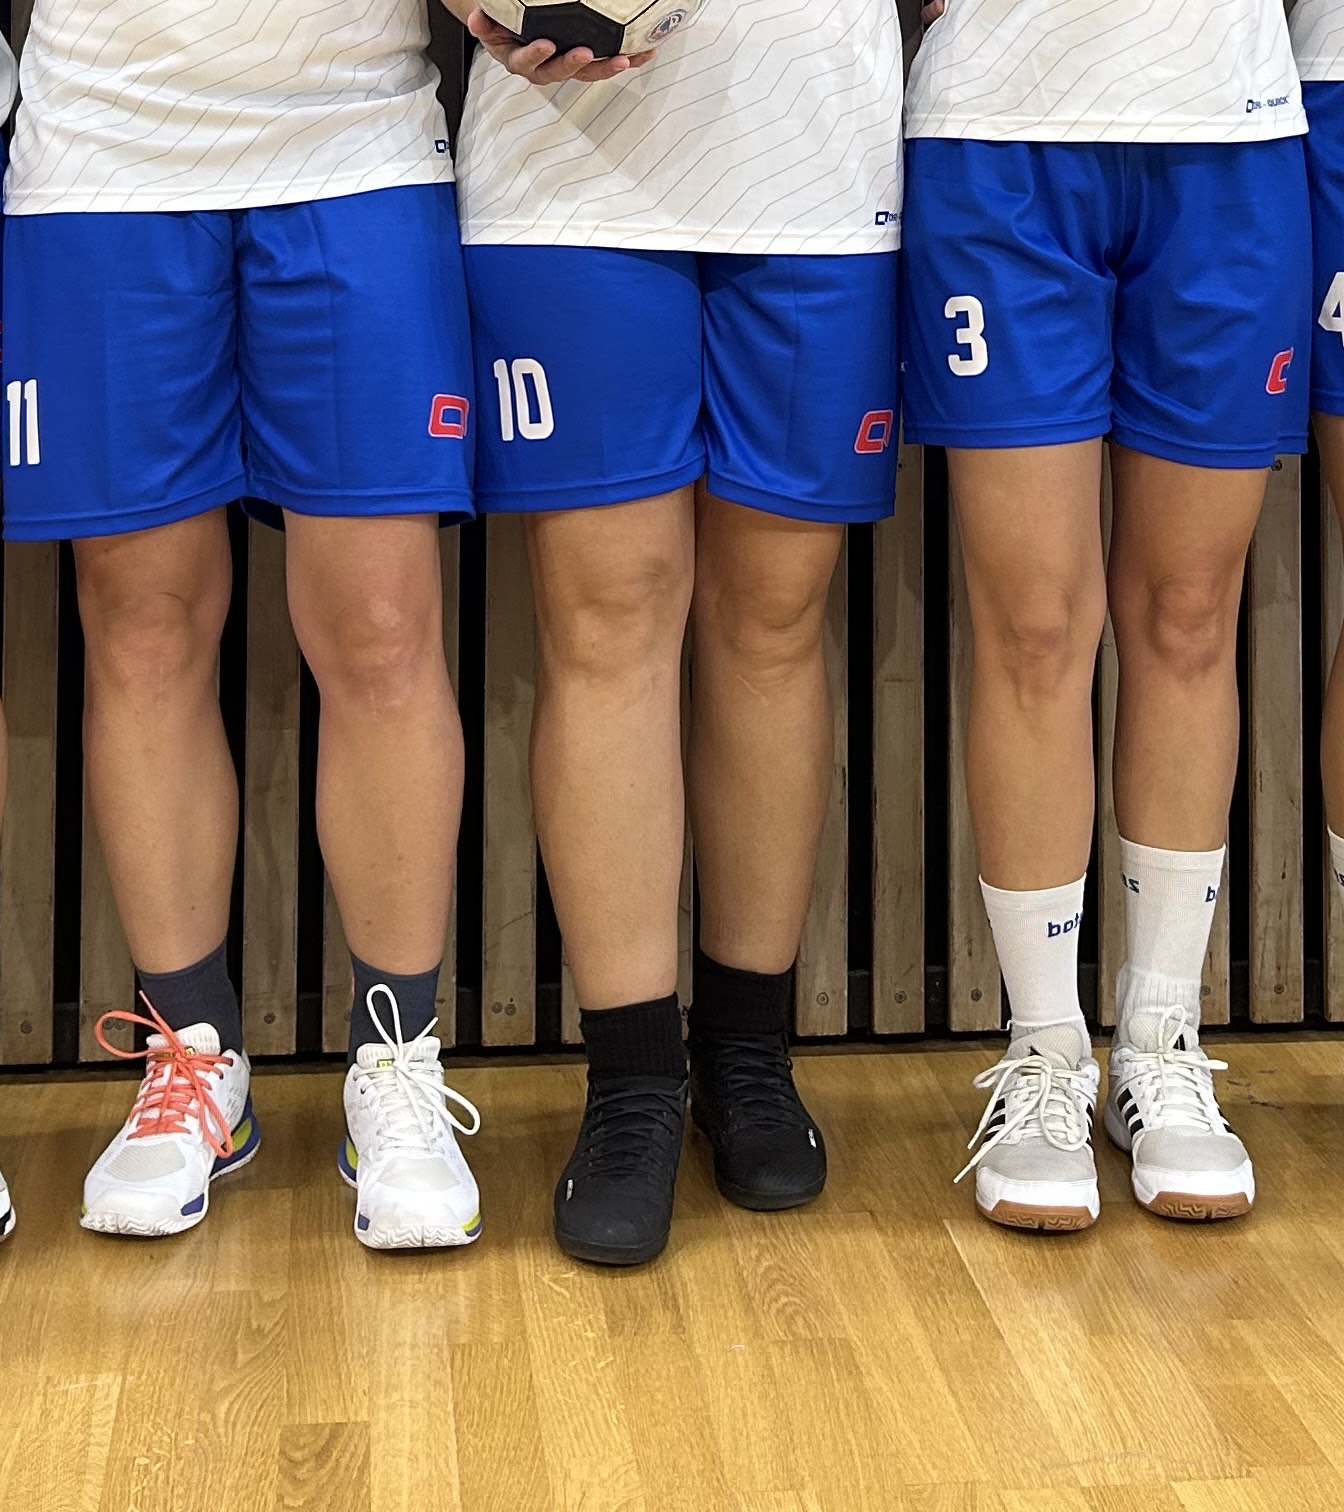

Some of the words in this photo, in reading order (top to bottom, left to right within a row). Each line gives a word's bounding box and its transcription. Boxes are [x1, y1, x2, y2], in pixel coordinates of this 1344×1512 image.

[943, 295, 989, 377] 3
[7, 378, 40, 466] 11
[493, 358, 555, 441] 10
